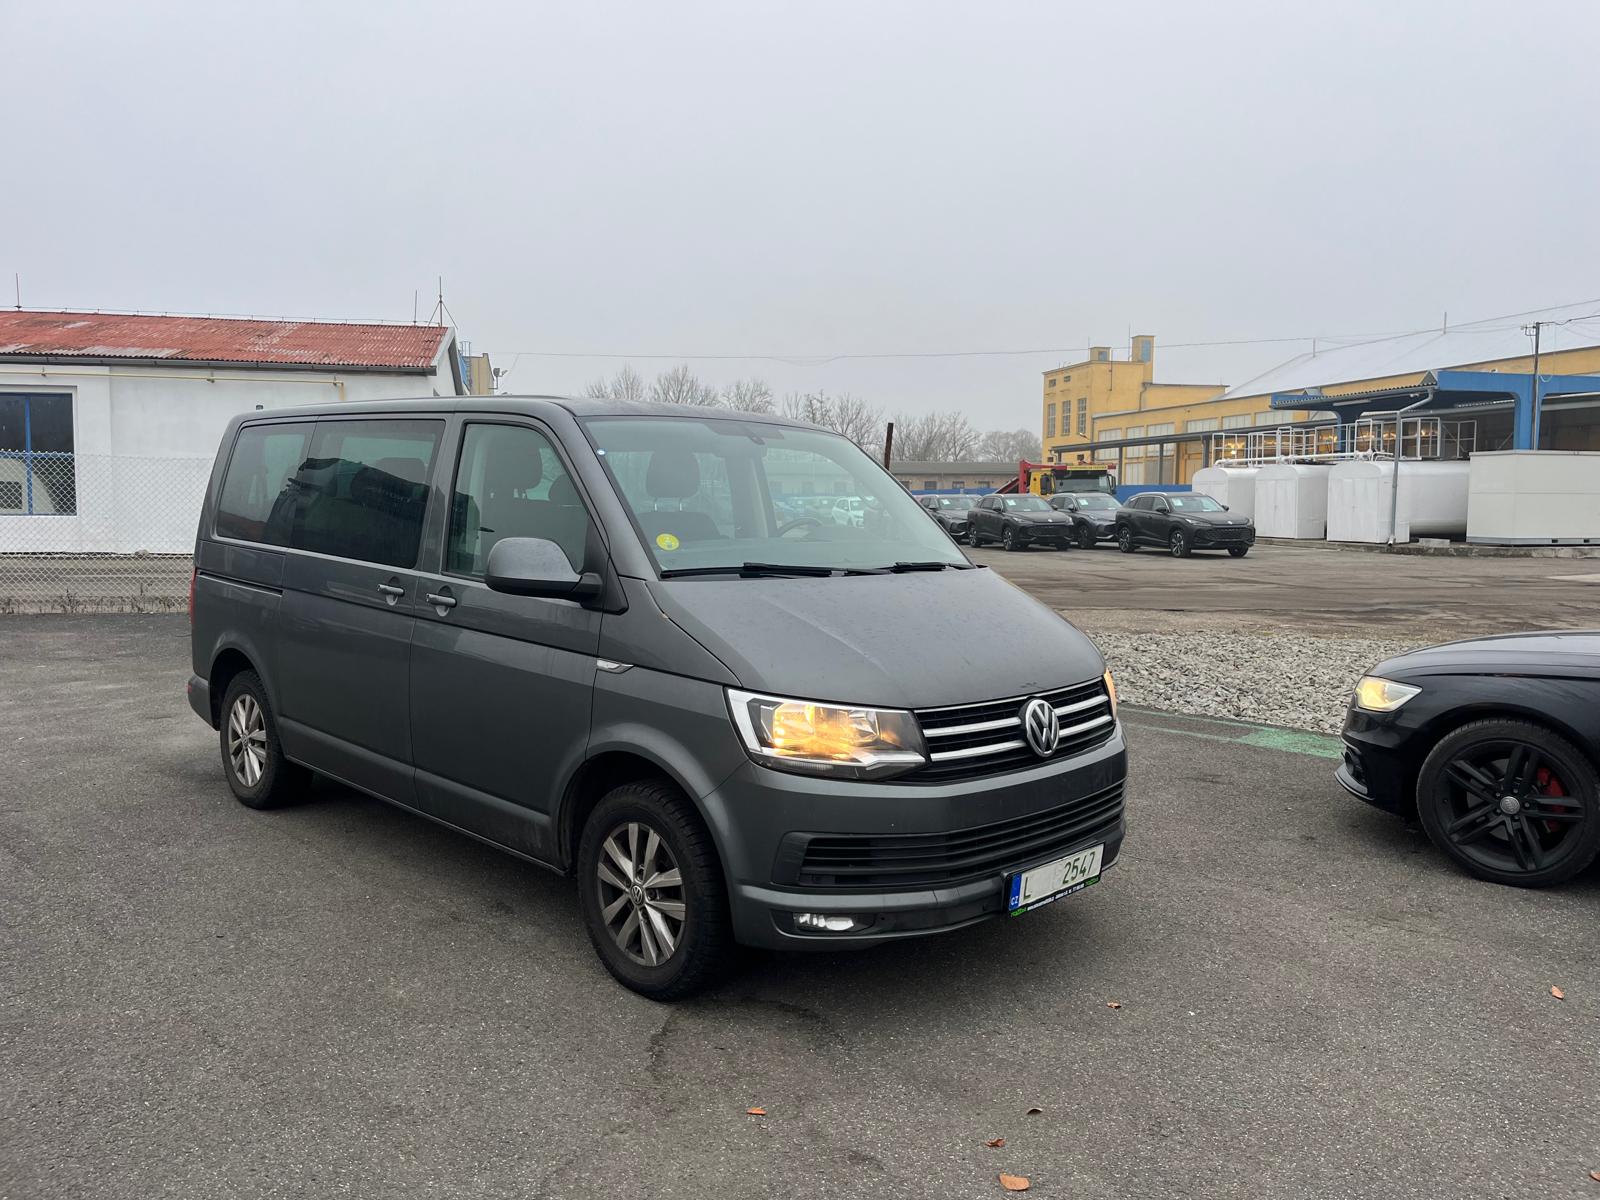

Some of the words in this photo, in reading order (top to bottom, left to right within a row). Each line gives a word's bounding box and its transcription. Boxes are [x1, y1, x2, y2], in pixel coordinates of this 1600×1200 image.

[1026, 699, 1059, 757] VW
[1022, 876, 1032, 902] L
[1062, 851, 1096, 885] 2547
[631, 885, 642, 904] VW
[1010, 896, 1019, 906] CZ
